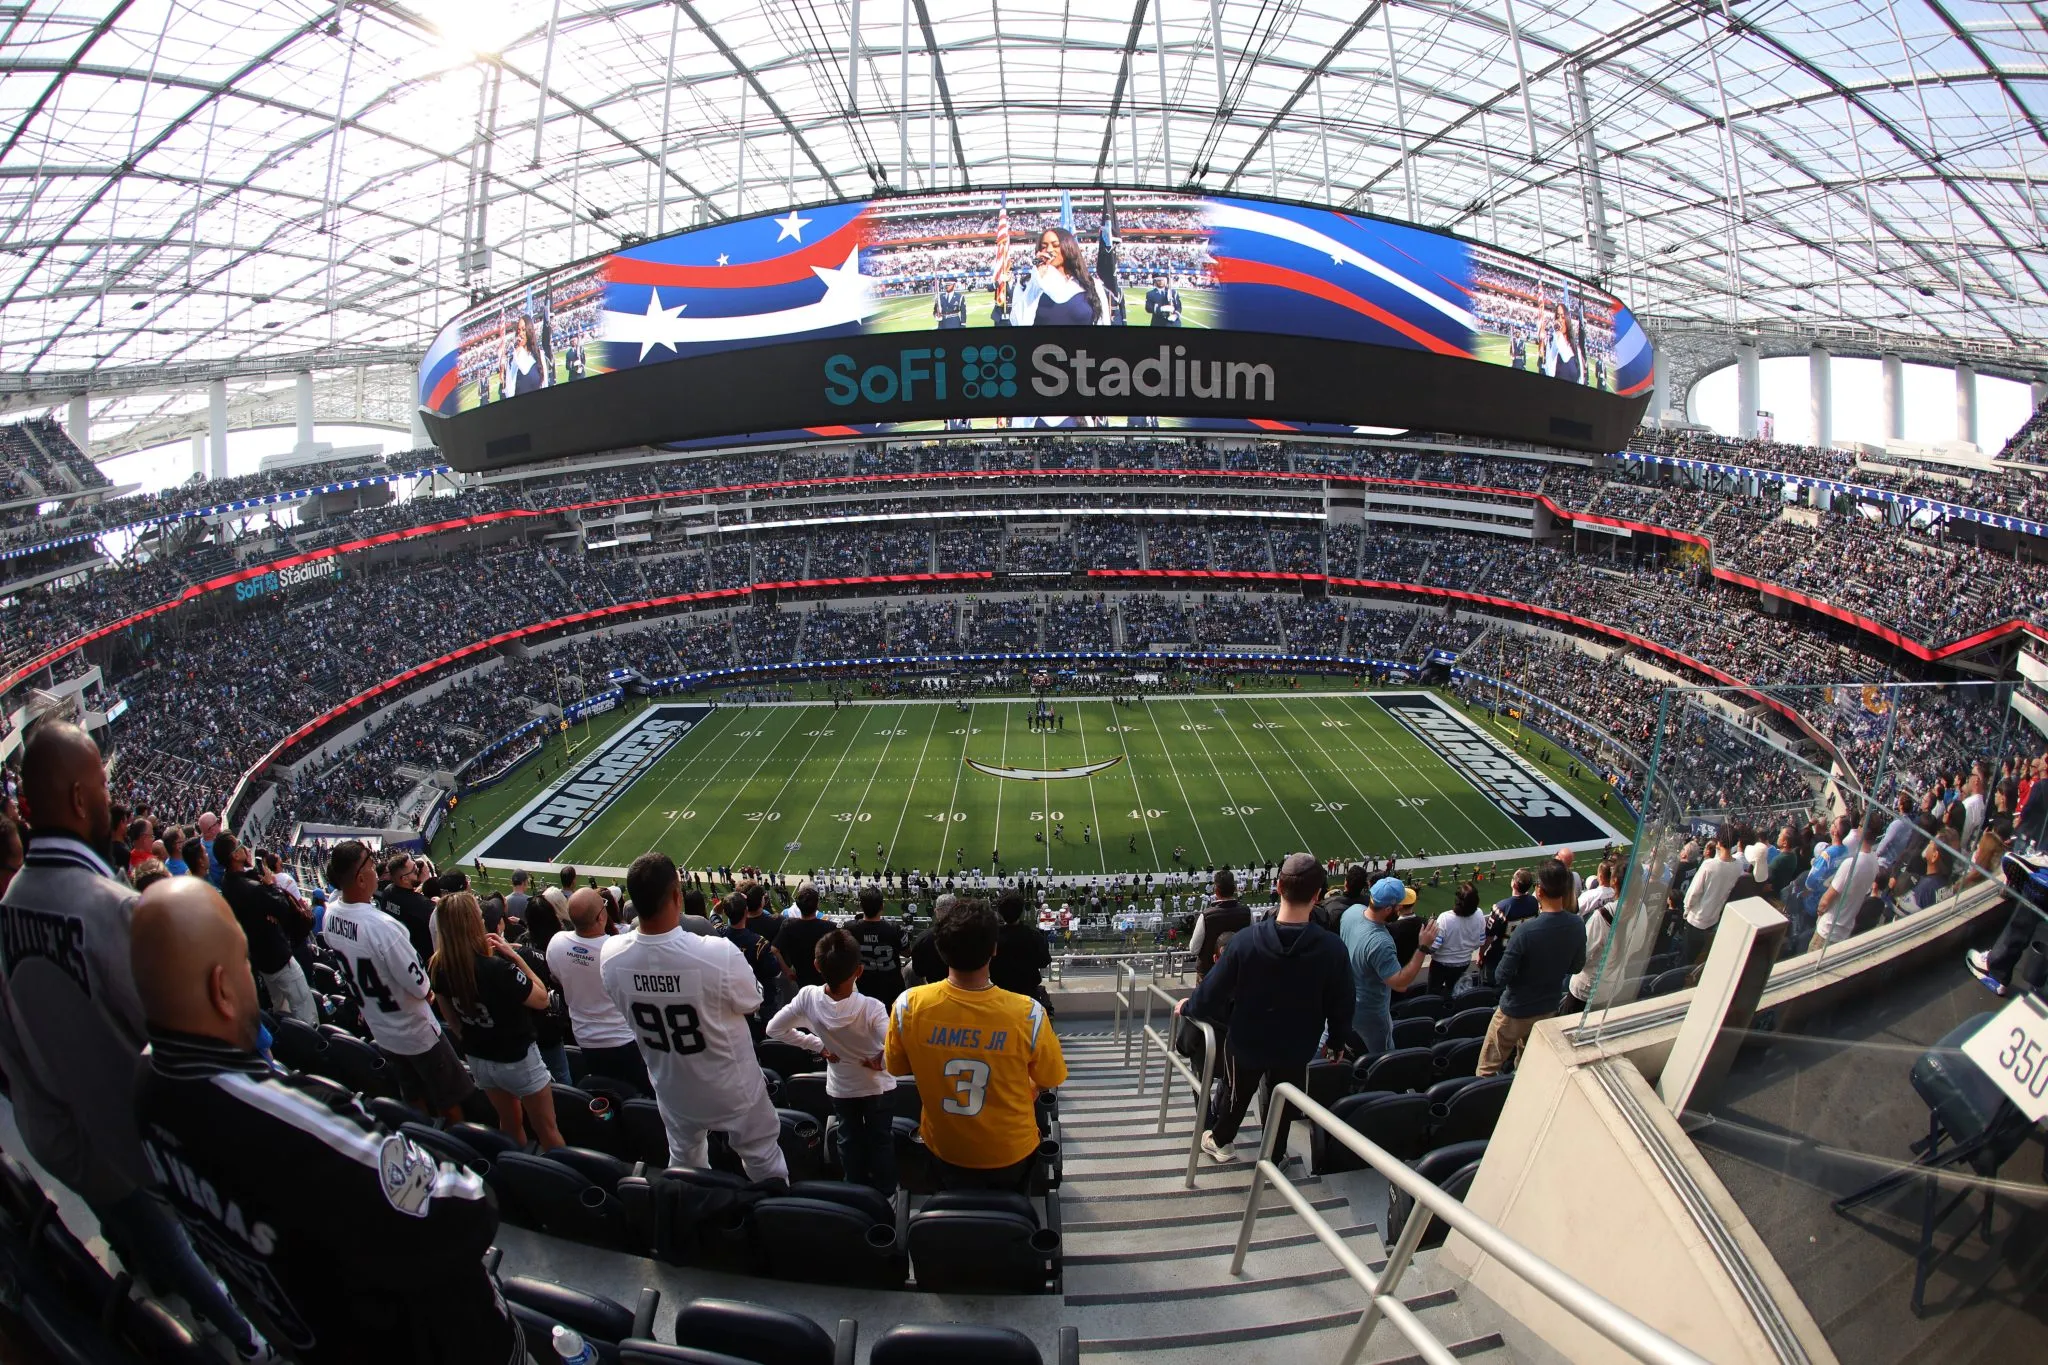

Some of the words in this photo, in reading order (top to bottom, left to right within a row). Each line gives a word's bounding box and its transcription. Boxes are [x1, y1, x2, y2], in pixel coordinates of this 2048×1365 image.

[825, 347, 947, 405] SoFi
[1032, 344, 1275, 401] Stadium
[236, 577, 264, 601] SoFi
[279, 562, 333, 587] Stadium
[1388, 706, 1571, 818] CHARGERS
[1504, 751, 1523, 762] ALL
[1522, 764, 1537, 773] OF
[1535, 774, 1552, 784] US
[523, 719, 692, 838] CHARGERS
[1311, 802, 1344, 813] 20
[1395, 798, 1425, 808] 10
[666, 810, 696, 820] 10
[746, 811, 781, 822] 20
[837, 812, 872, 822] 30
[932, 812, 967, 822] 40
[1030, 810, 1064, 821] 50
[1127, 808, 1161, 819] 40
[1220, 805, 1254, 817] 30
[328, 915, 359, 942] JACKSON
[566, 951, 595, 962] MUSTANG
[634, 975, 681, 993] CROSBY
[632, 1002, 707, 1056] 98
[927, 1026, 981, 1049] JAMES
[984, 1031, 1008, 1051] JR
[943, 1058, 992, 1117] 3
